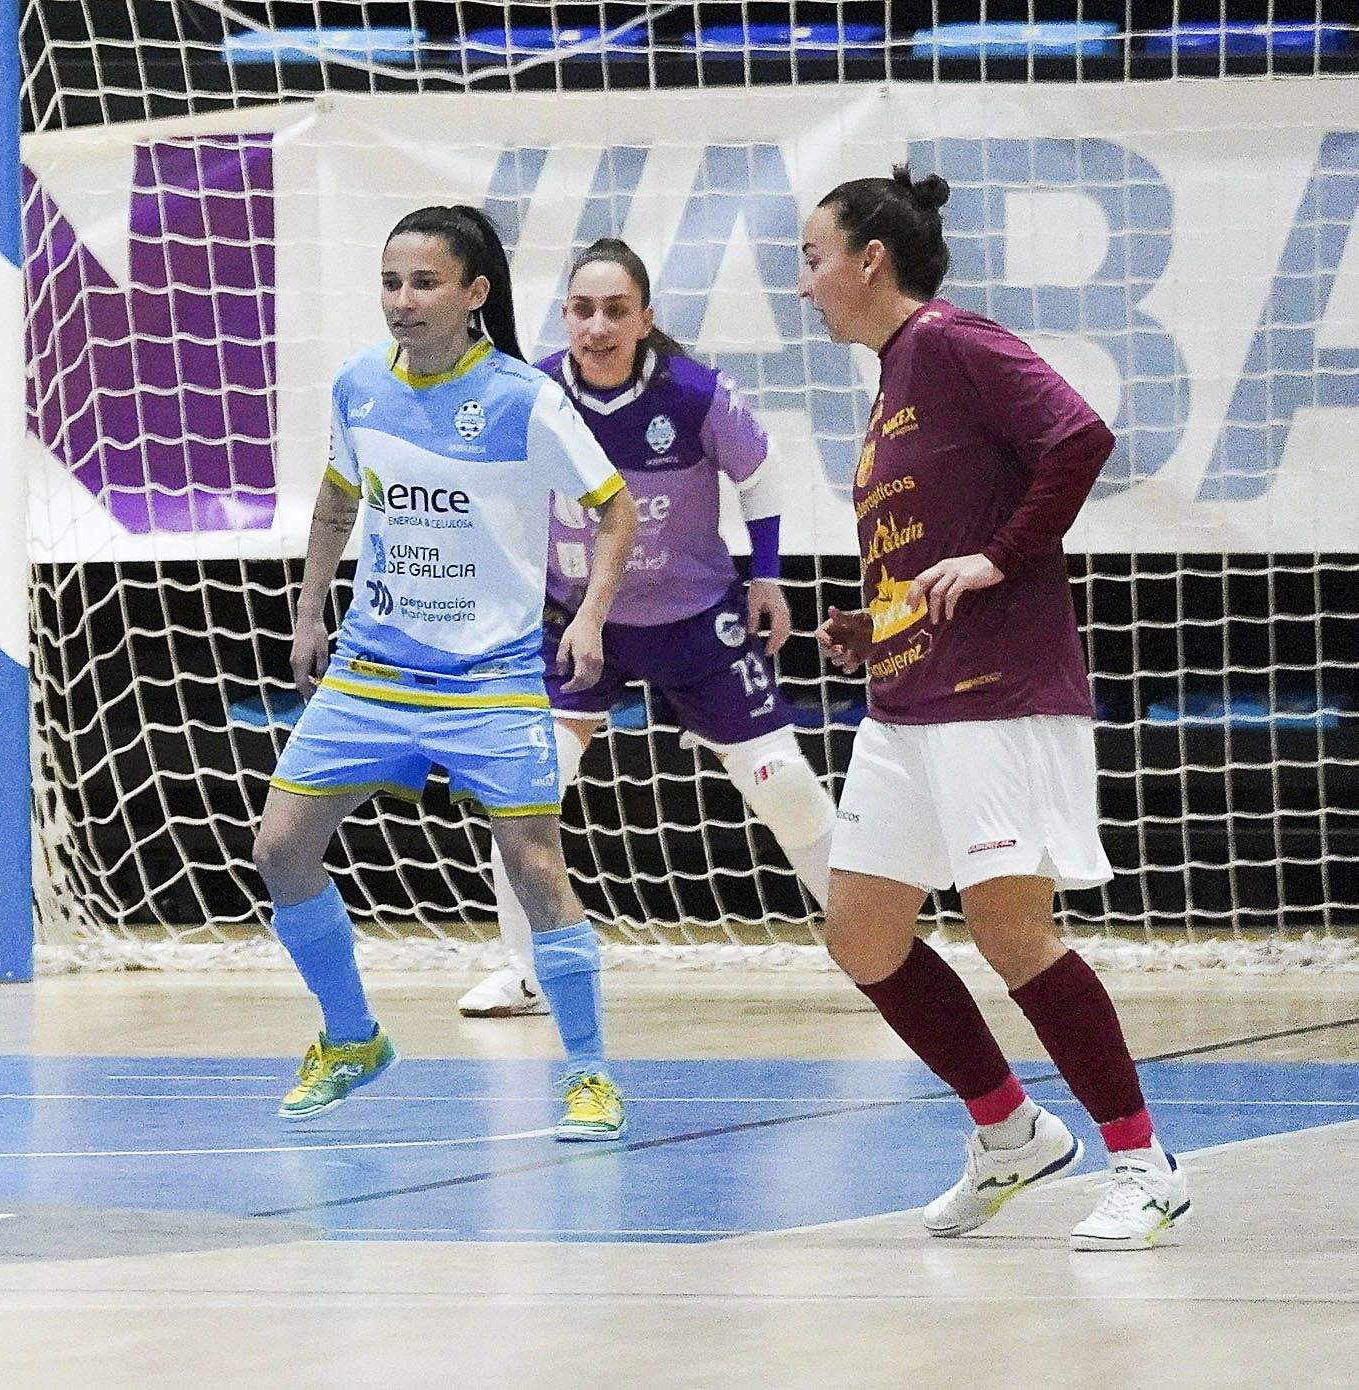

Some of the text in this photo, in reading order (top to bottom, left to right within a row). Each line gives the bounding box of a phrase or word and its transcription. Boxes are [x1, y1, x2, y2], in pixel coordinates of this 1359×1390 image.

[387, 483, 470, 514] ence
[387, 561, 476, 578] DE GALICIA
[399, 596, 476, 611] Deputación
